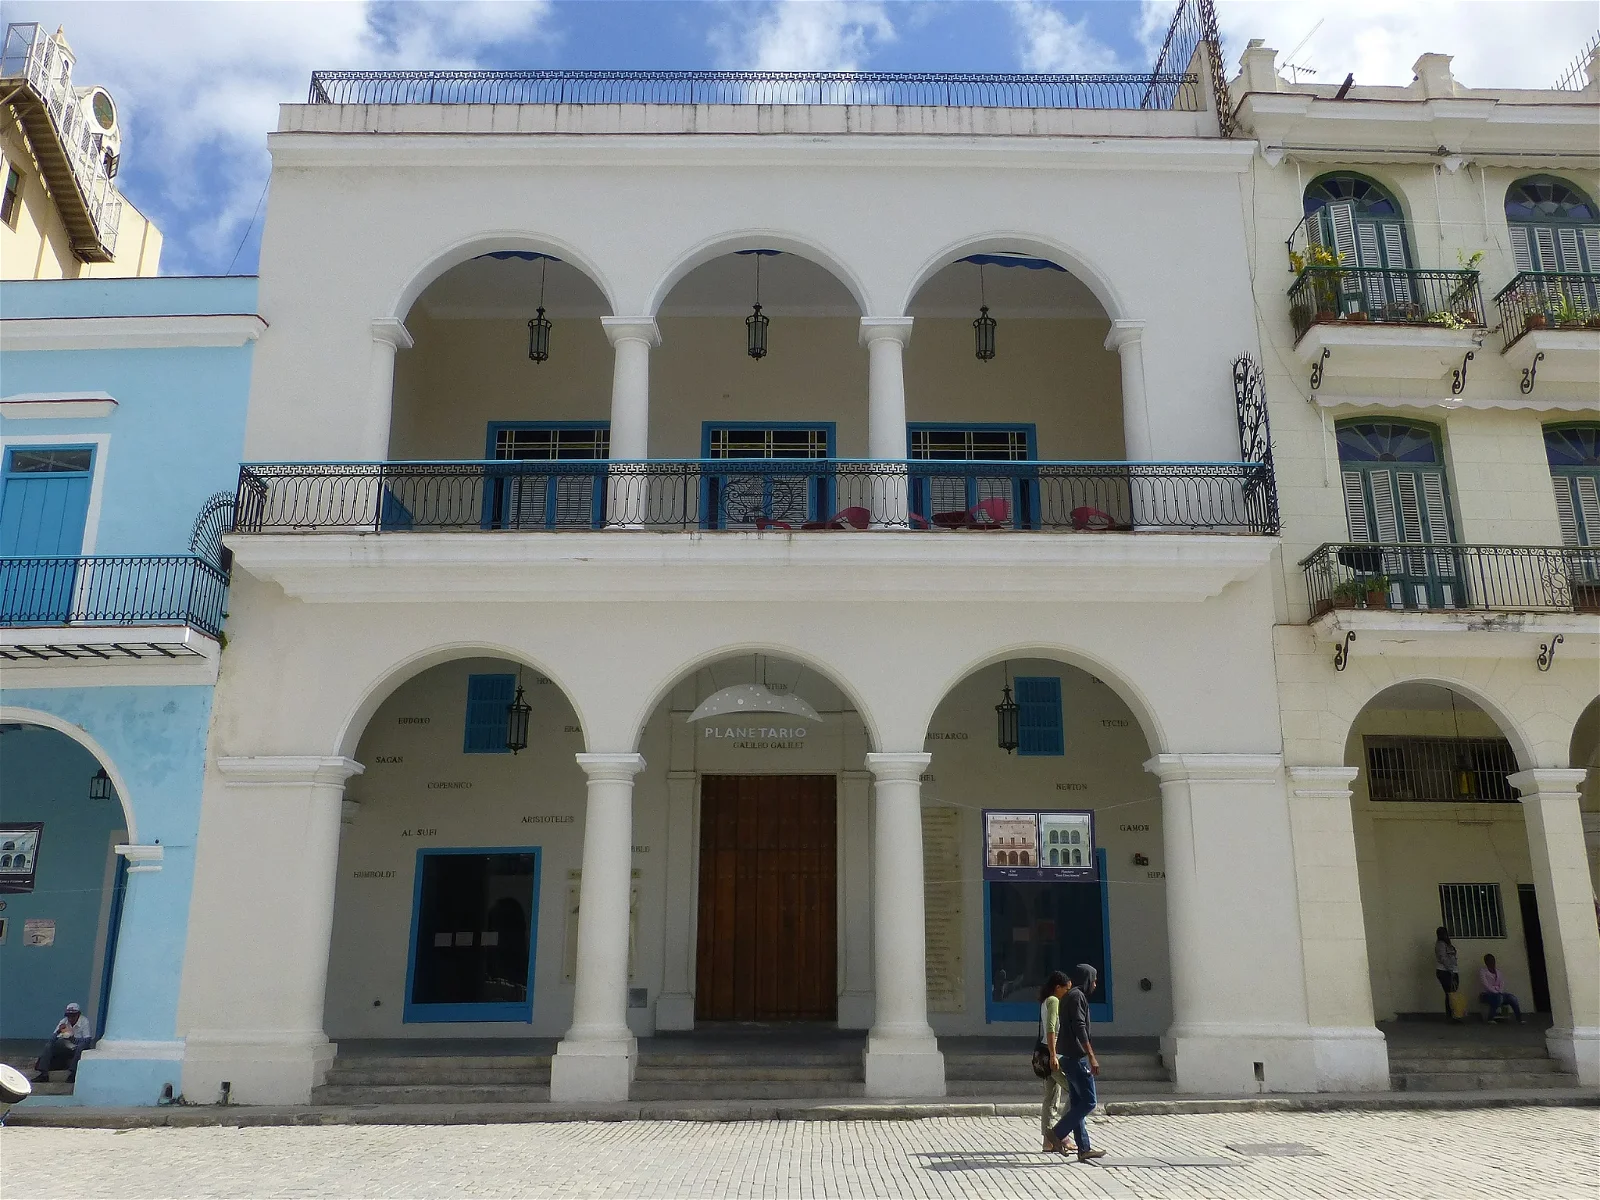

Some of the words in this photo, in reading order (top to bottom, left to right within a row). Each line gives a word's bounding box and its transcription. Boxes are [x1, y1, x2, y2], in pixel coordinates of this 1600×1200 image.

[564, 725, 583, 733] ERA
[704, 727, 807, 739] PLANETARIO
[925, 732, 969, 740] RISTARCO
[732, 741, 769, 749] GALILEO
[770, 741, 804, 749] GALILEI
[375, 756, 404, 764] SAGAN
[1055, 783, 1088, 791] NEWTON
[521, 815, 575, 823] ARISTOTELES
[401, 829, 413, 837] AL
[353, 870, 397, 878] HUMBOLDT
